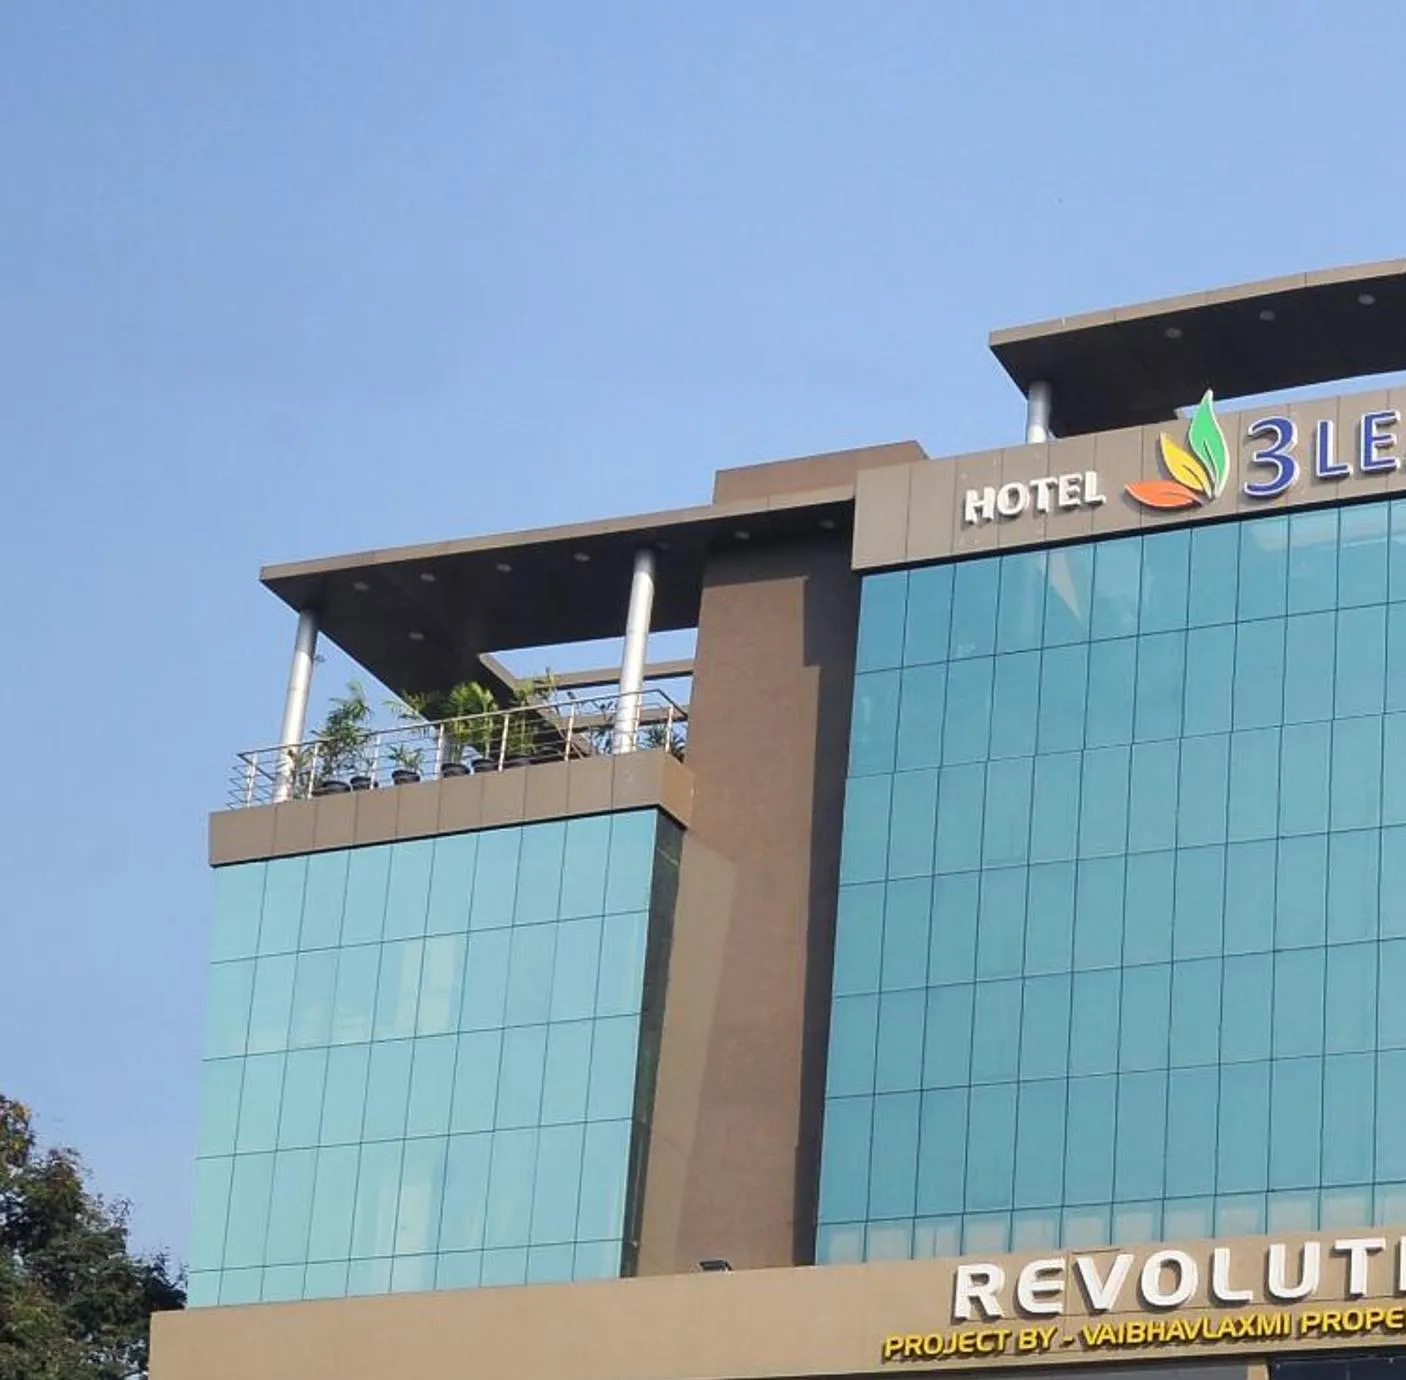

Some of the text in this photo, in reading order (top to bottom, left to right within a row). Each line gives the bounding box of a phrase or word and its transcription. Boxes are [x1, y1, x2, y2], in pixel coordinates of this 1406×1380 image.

[964, 470, 1107, 523] HOTEL
[1243, 415, 1301, 497] 3
[884, 1328, 1011, 1358] PROJECT
[1018, 1325, 1058, 1350] BY
[1081, 1312, 1292, 1346] VAIBHAVLAXMI
